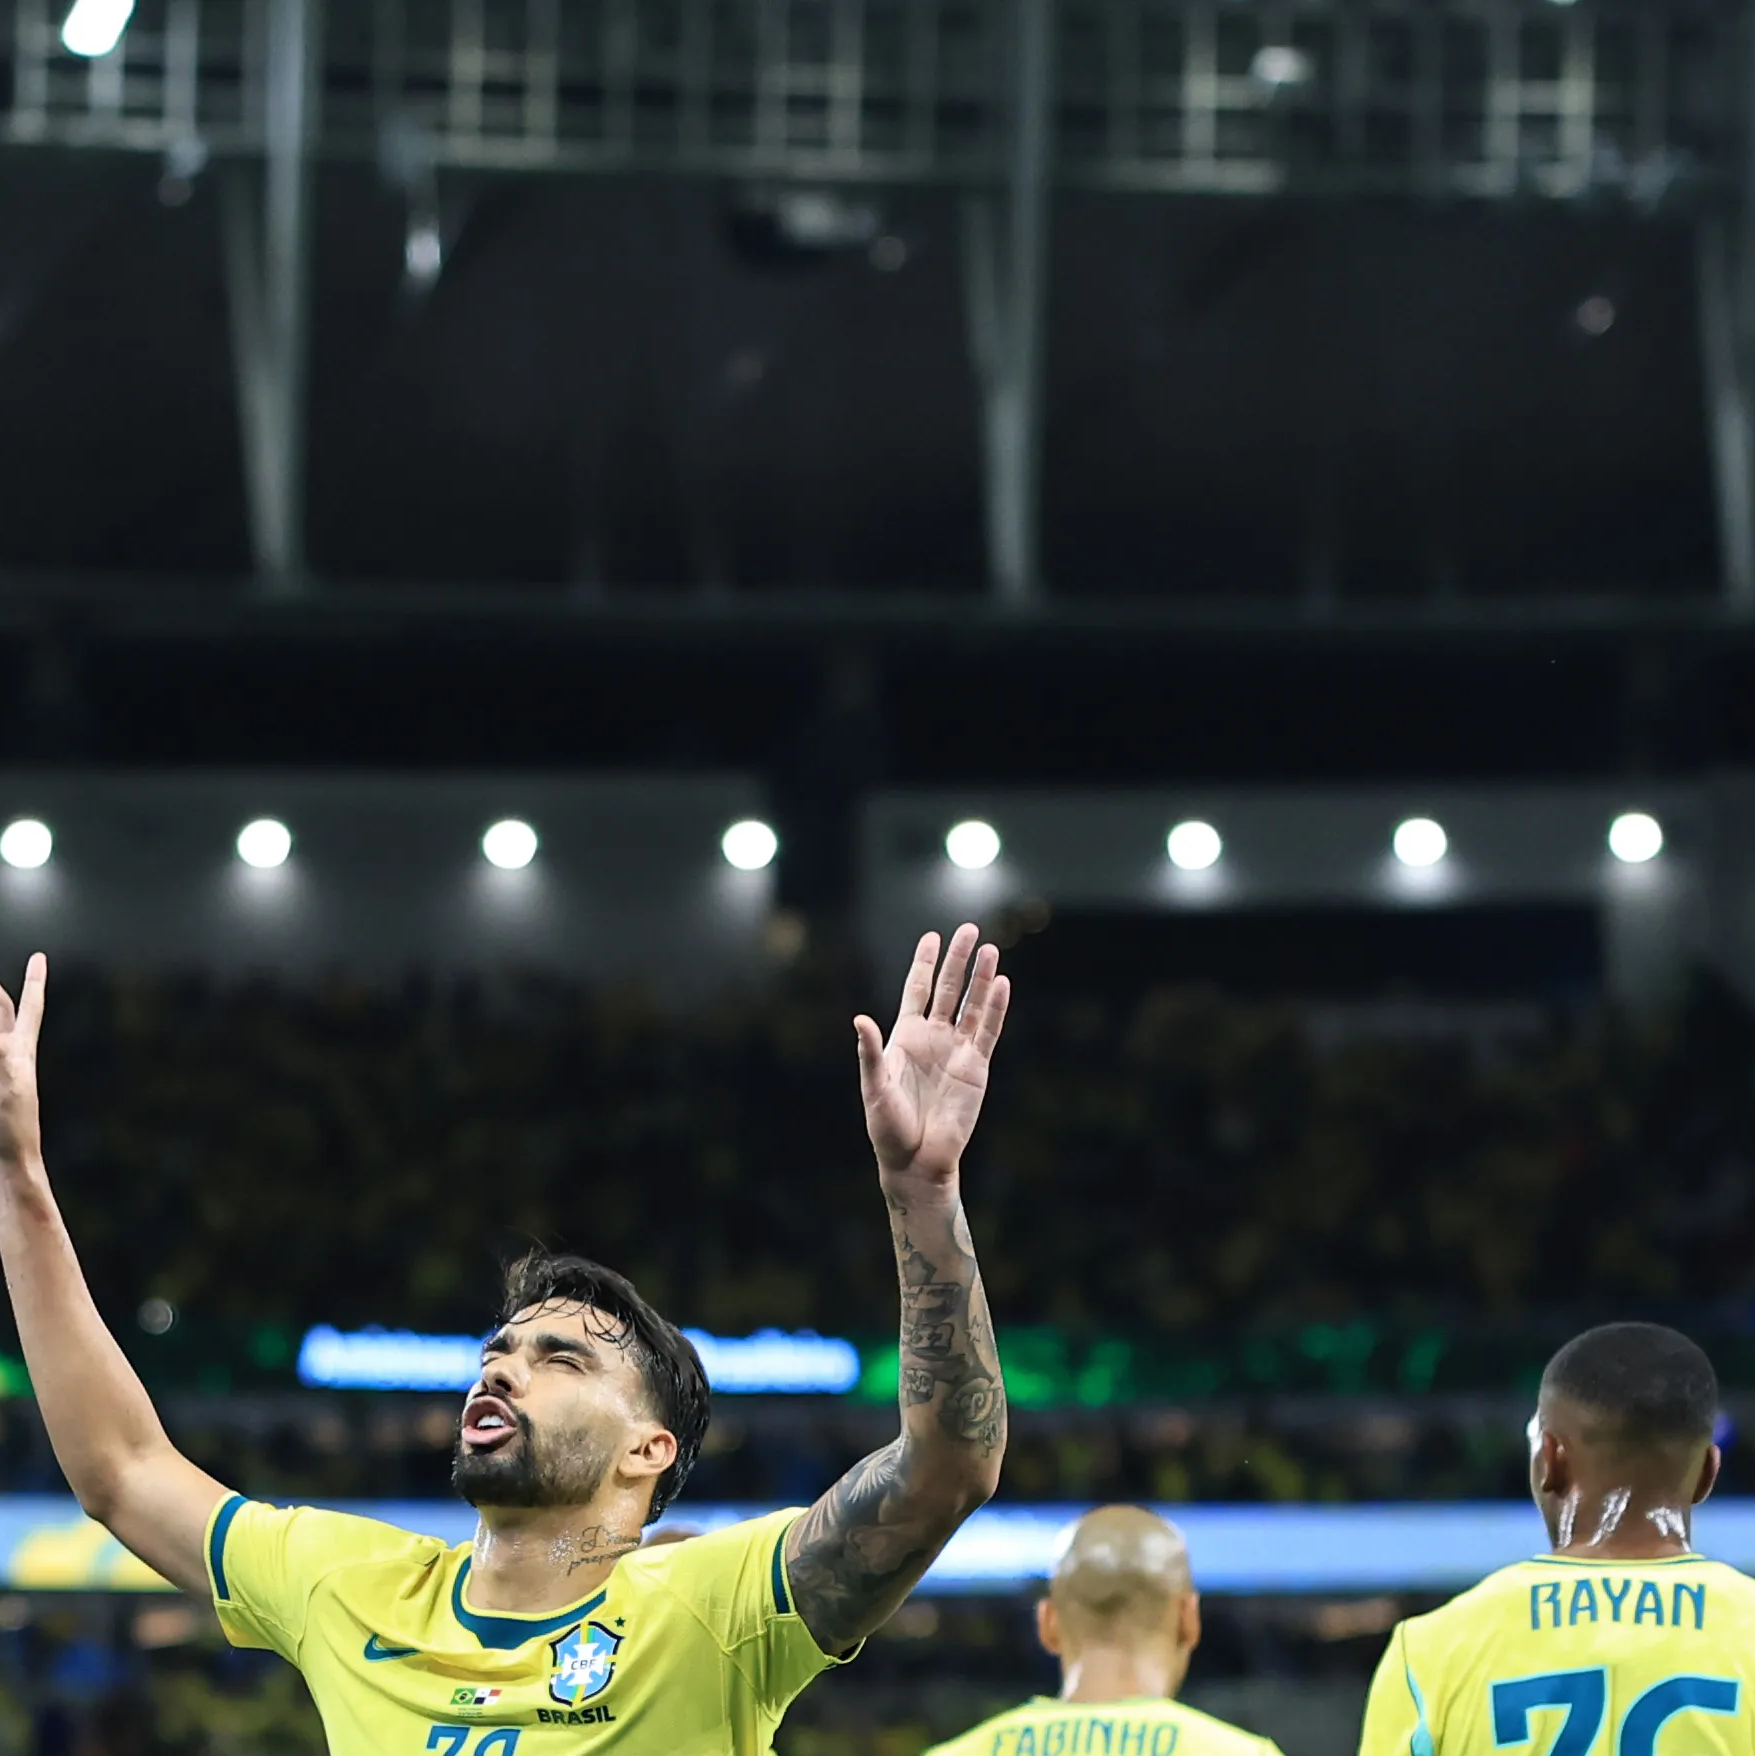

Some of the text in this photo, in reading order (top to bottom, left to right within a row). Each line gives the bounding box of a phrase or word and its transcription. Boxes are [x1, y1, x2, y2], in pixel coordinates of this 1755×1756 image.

[1531, 1577, 1705, 1631] RAYAN
[571, 1659, 596, 1670] CBF
[537, 1705, 616, 1725] BRASIL
